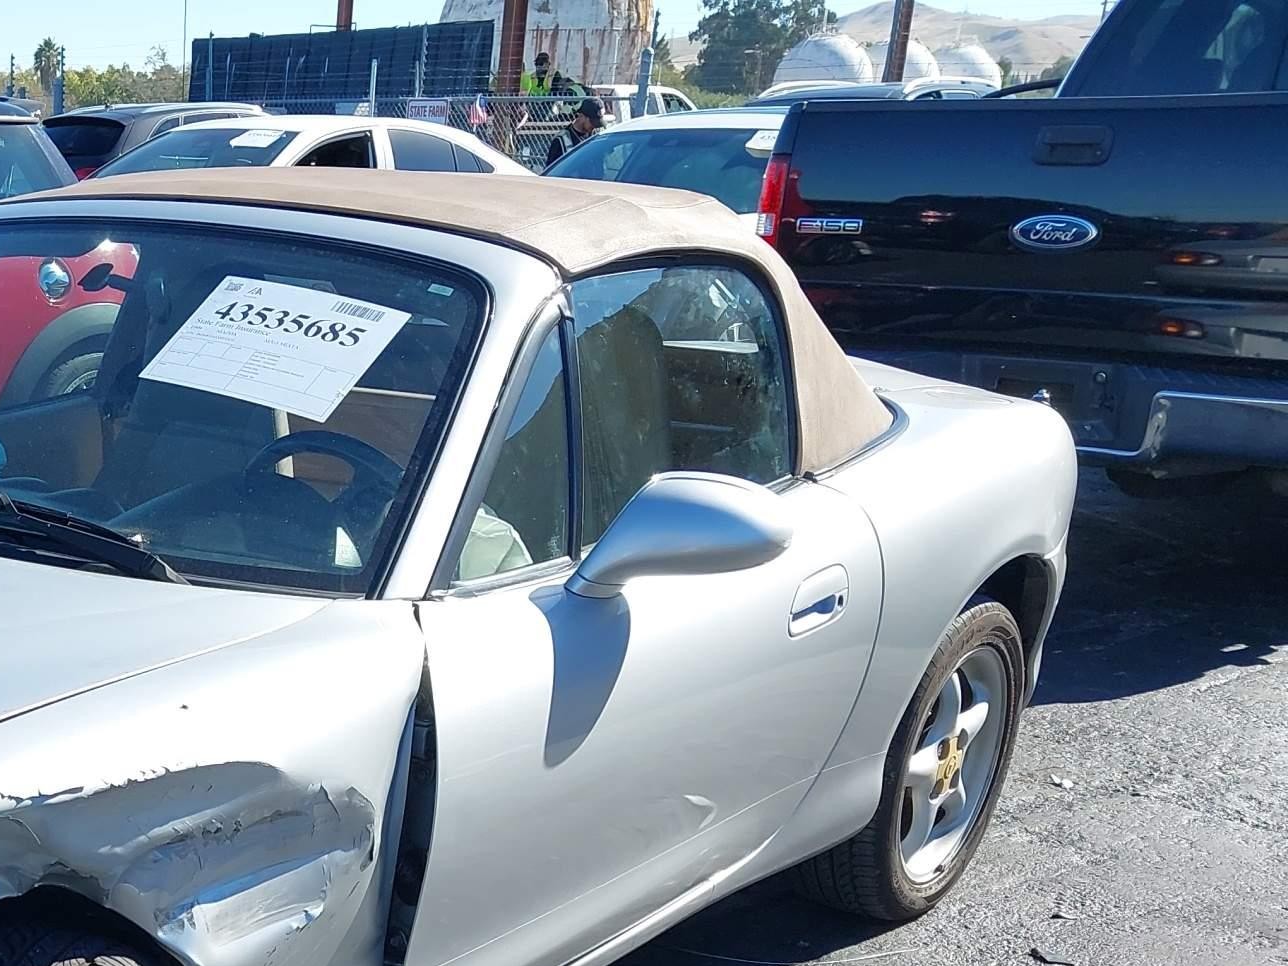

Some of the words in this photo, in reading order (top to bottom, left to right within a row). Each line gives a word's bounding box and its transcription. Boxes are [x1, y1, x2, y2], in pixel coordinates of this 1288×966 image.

[409, 105, 428, 118] STATE
[428, 105, 446, 118] FARM
[1030, 221, 1078, 241] Ford
[196, 317, 214, 327] State
[214, 320, 234, 330] Farm
[234, 324, 272, 337] Insurance
[214, 301, 368, 347] 43535685
